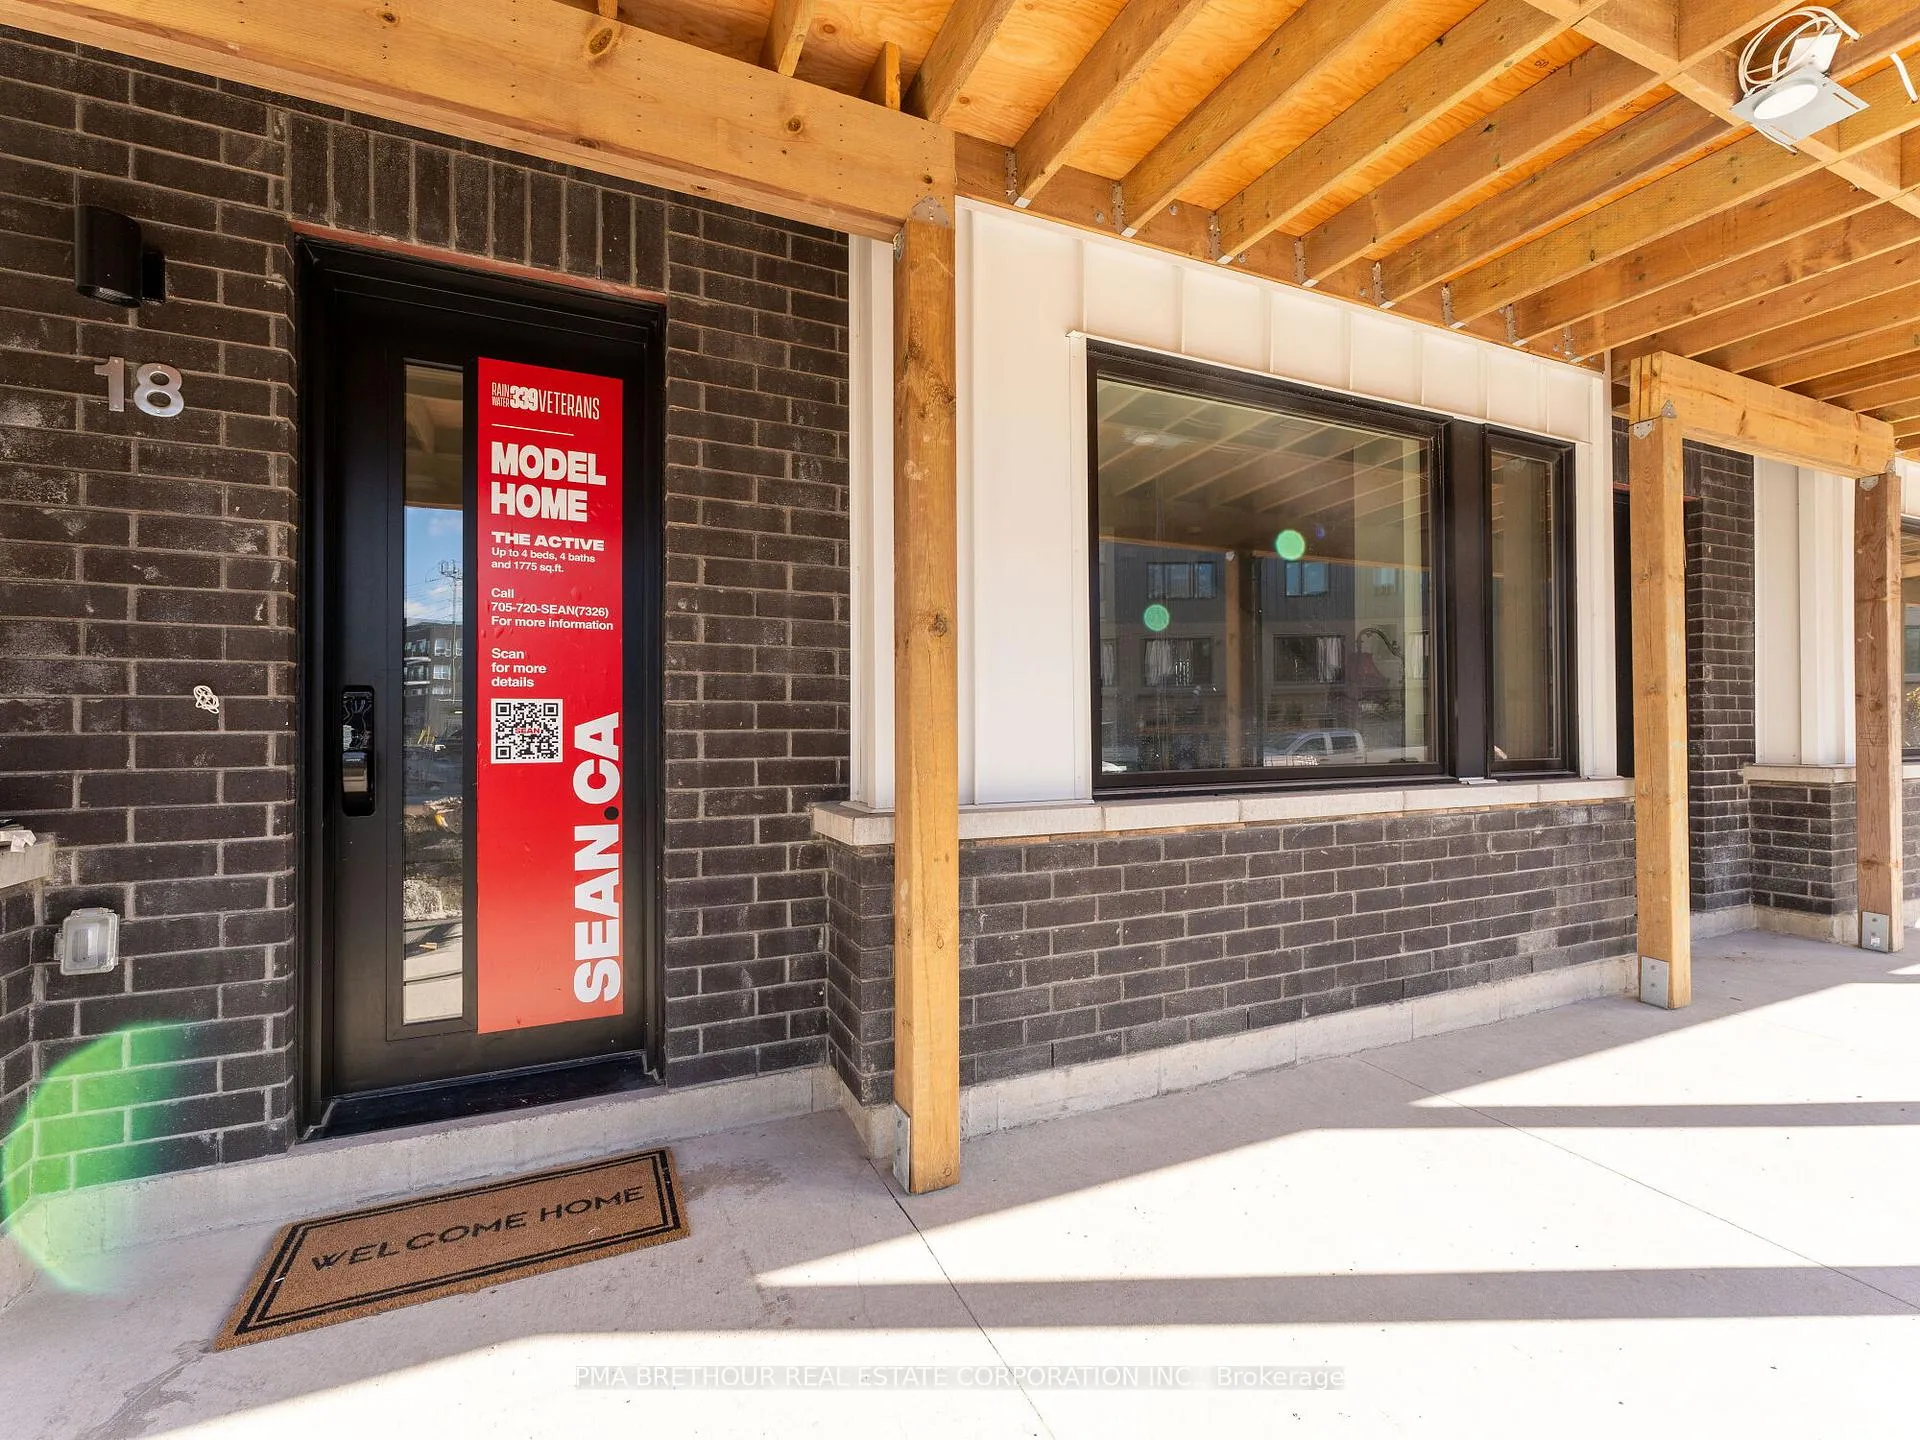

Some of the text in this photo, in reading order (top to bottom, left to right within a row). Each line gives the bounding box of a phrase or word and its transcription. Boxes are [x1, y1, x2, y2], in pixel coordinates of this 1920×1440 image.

[94, 356, 184, 417] 18
[492, 382, 509, 397] RAIN
[492, 396, 509, 407] WATER
[510, 385, 599, 420] 339 VETERANS
[491, 441, 606, 486] MODEL
[491, 481, 588, 522] HOME
[491, 531, 605, 551] THE ACTIVE
[491, 547, 596, 563] Up to 4 beds, 4 baths
[491, 561, 565, 573] and 1775 sq.ft.
[491, 587, 515, 598] Call
[491, 602, 609, 618] 705-720-SEAN(7326)
[491, 615, 613, 630] For more information
[491, 648, 525, 659] Scan
[491, 662, 547, 673] for more
[491, 676, 535, 688] details
[573, 711, 621, 1003] SEAN.CA
[311, 1186, 645, 1271] WELCOME HOME
